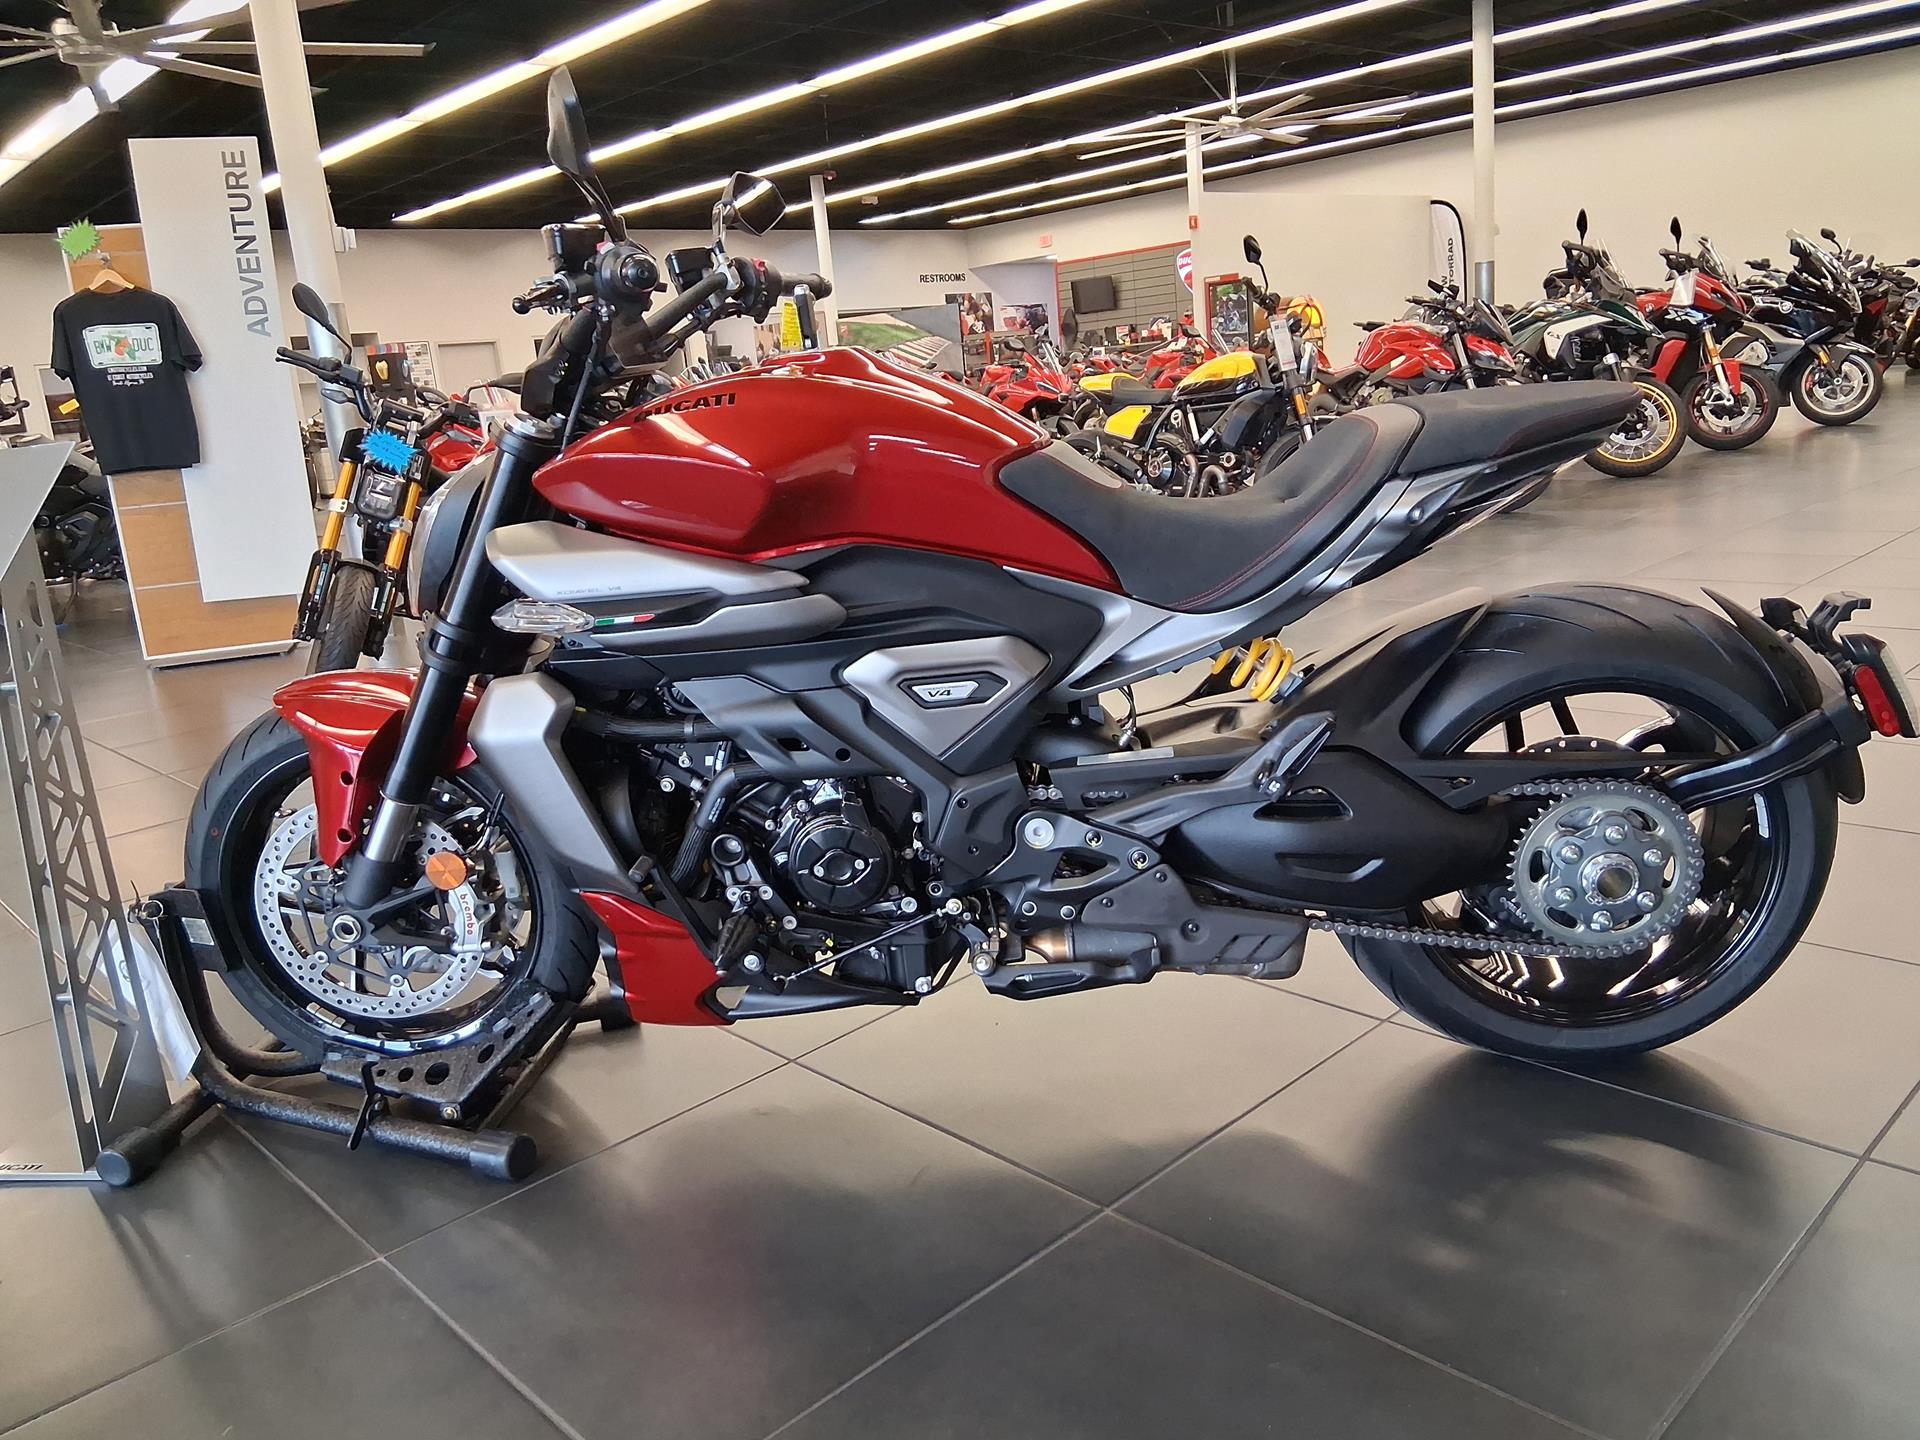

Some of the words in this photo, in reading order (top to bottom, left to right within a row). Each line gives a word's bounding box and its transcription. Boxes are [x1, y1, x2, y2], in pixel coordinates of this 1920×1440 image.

[221, 150, 272, 338] ADVENTURE
[1447, 237, 1455, 286] TORRAD
[919, 272, 967, 284] RESTROOMS
[131, 337, 155, 352] DUC
[634, 392, 737, 422] DUCATI
[927, 689, 952, 698] V4
[459, 893, 476, 936] brembo
